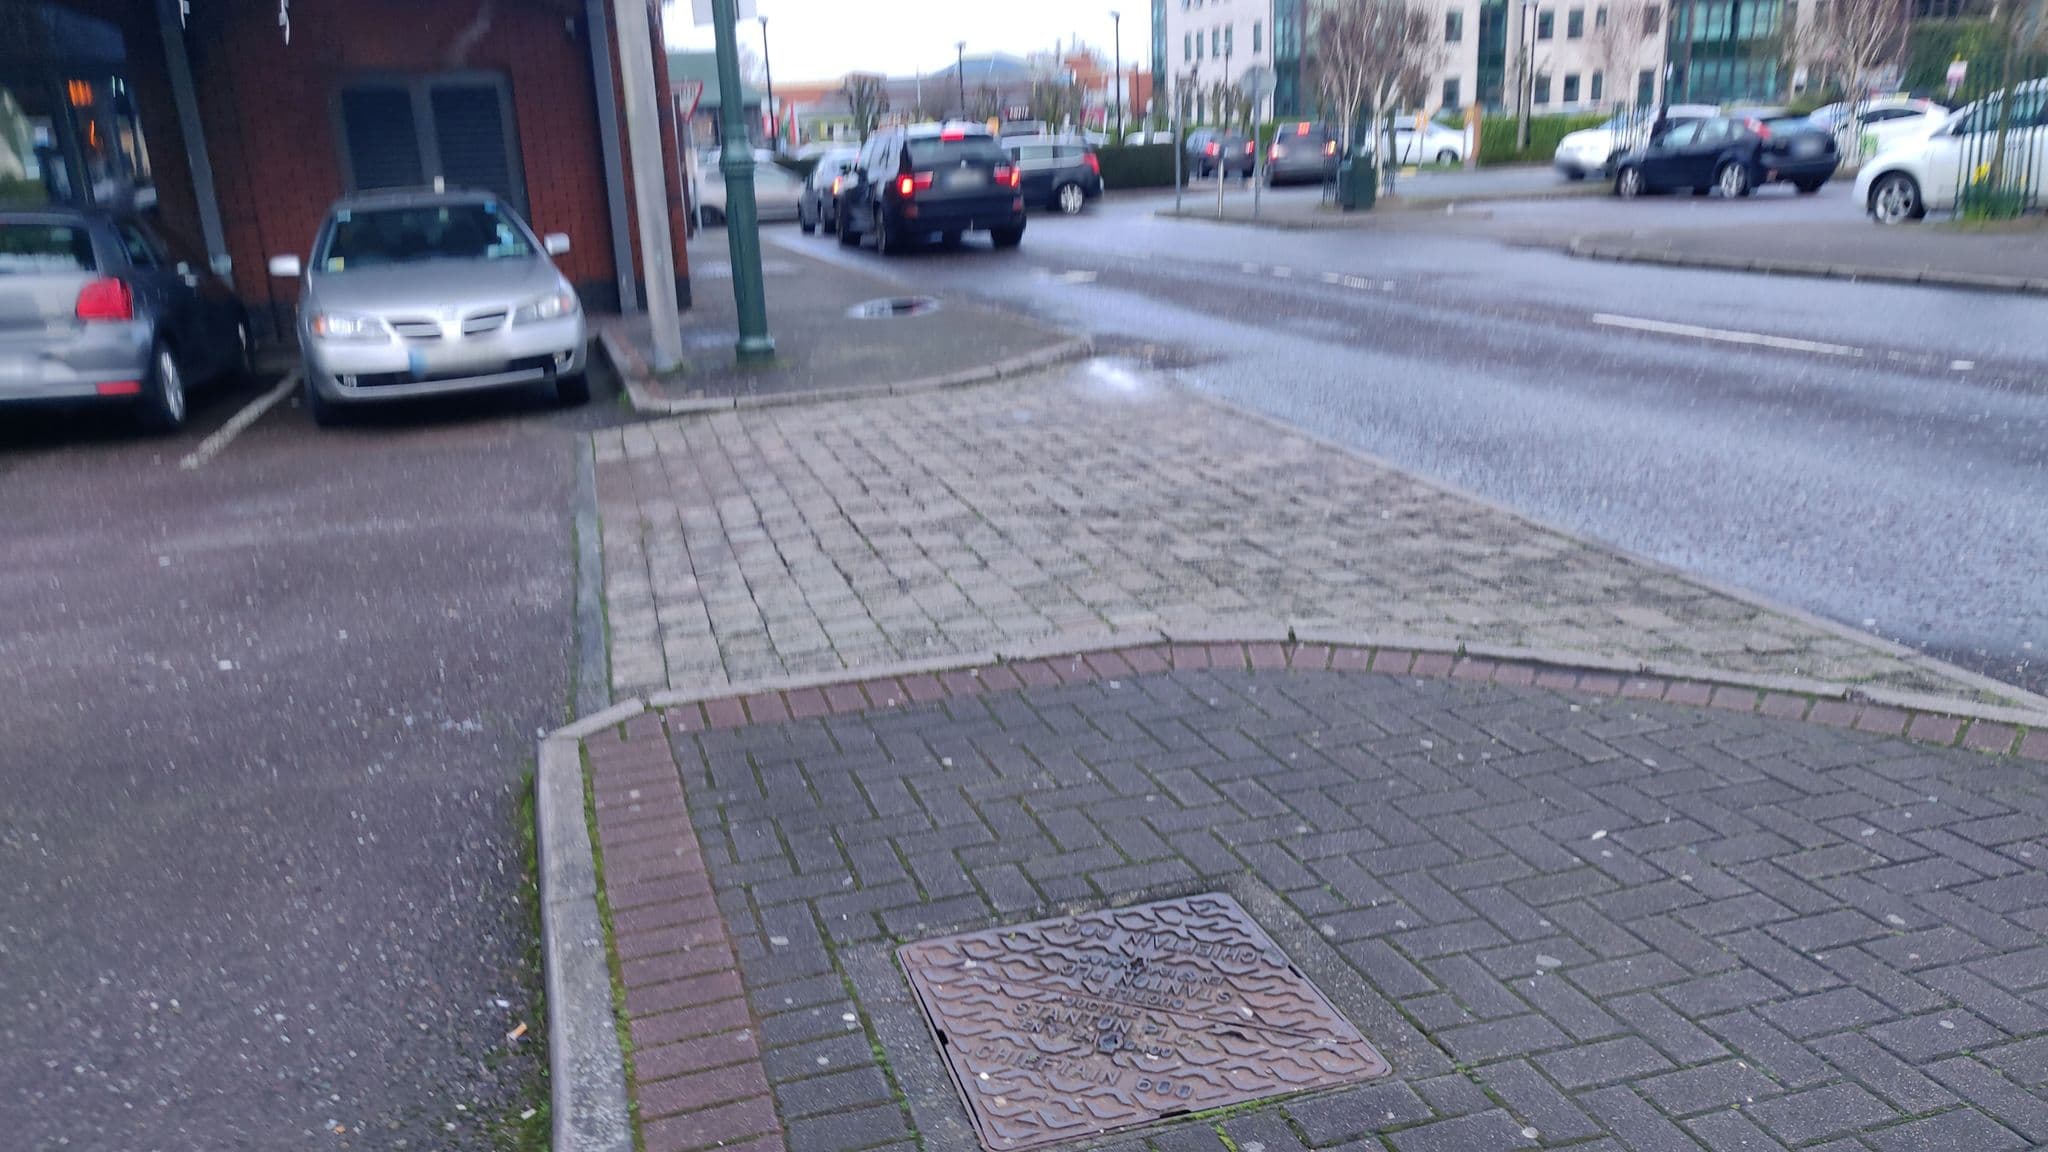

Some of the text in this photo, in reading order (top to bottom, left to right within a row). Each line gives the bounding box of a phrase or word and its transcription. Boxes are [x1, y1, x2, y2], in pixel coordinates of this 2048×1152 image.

[1125, 932, 1257, 964] CHIEFTAIN
[1060, 961, 1109, 982] PLC
[1115, 971, 1232, 1003] STANTON
[1105, 987, 1185, 1009] DUCTILE
[1012, 1002, 1194, 1046] STANTON PLC
[974, 1044, 1122, 1087] CHIEFTAIN
